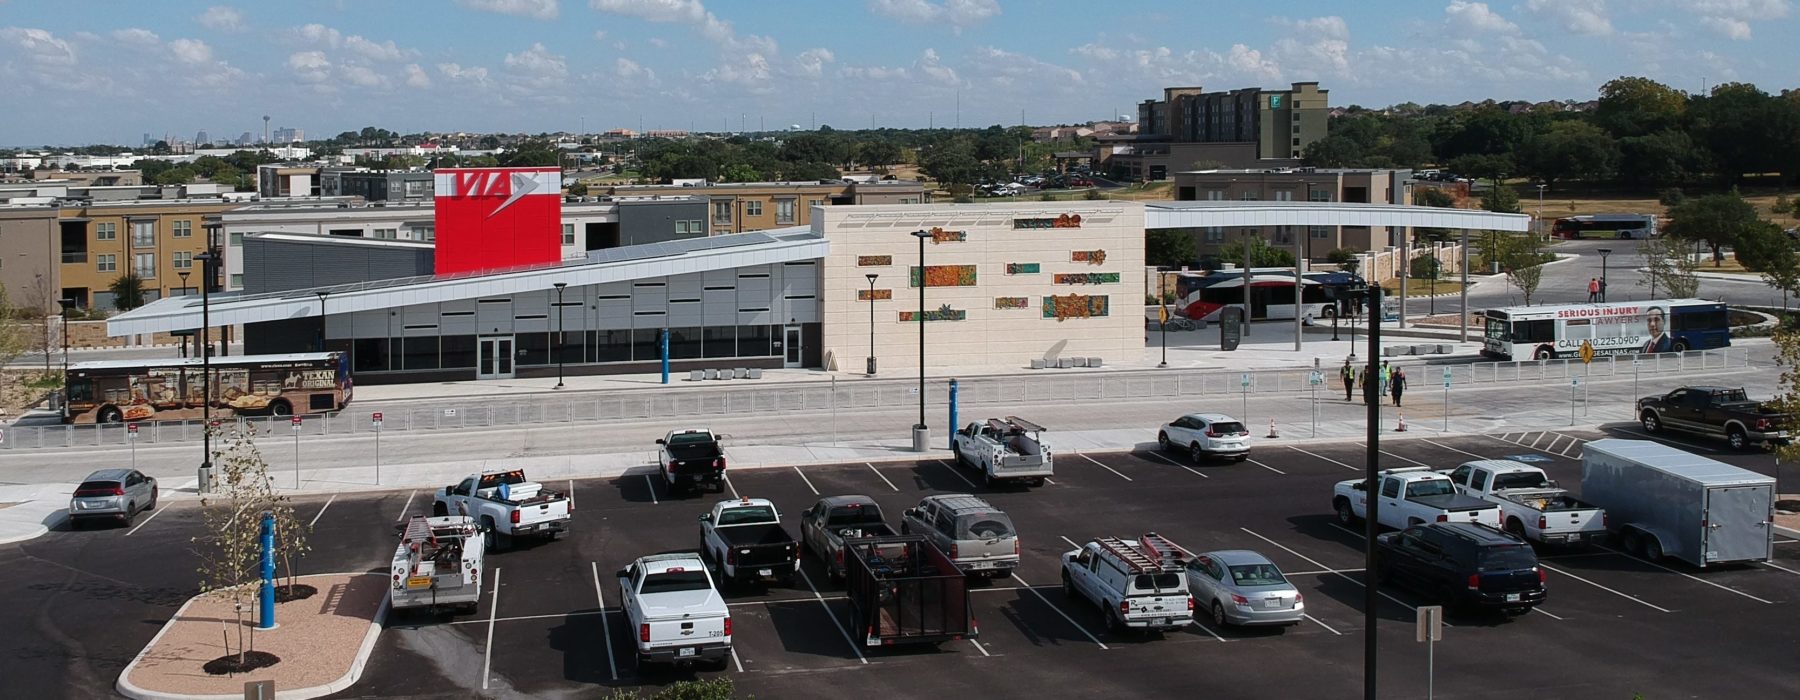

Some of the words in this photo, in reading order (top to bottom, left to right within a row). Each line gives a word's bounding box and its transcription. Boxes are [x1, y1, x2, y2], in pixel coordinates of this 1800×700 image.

[455, 170, 512, 196] VIA
[1558, 308, 1600, 318] SERIOUS
[1603, 307, 1639, 315] INJURY
[1592, 315, 1640, 325] LAWYERS
[1558, 339, 1582, 348] CALL
[1588, 335, 1640, 346] 10.225.0909
[1558, 348, 1640, 358] www.GGESALINAS.com
[302, 370, 336, 380] TEXAN
[302, 379, 336, 388] ORIGINAL
